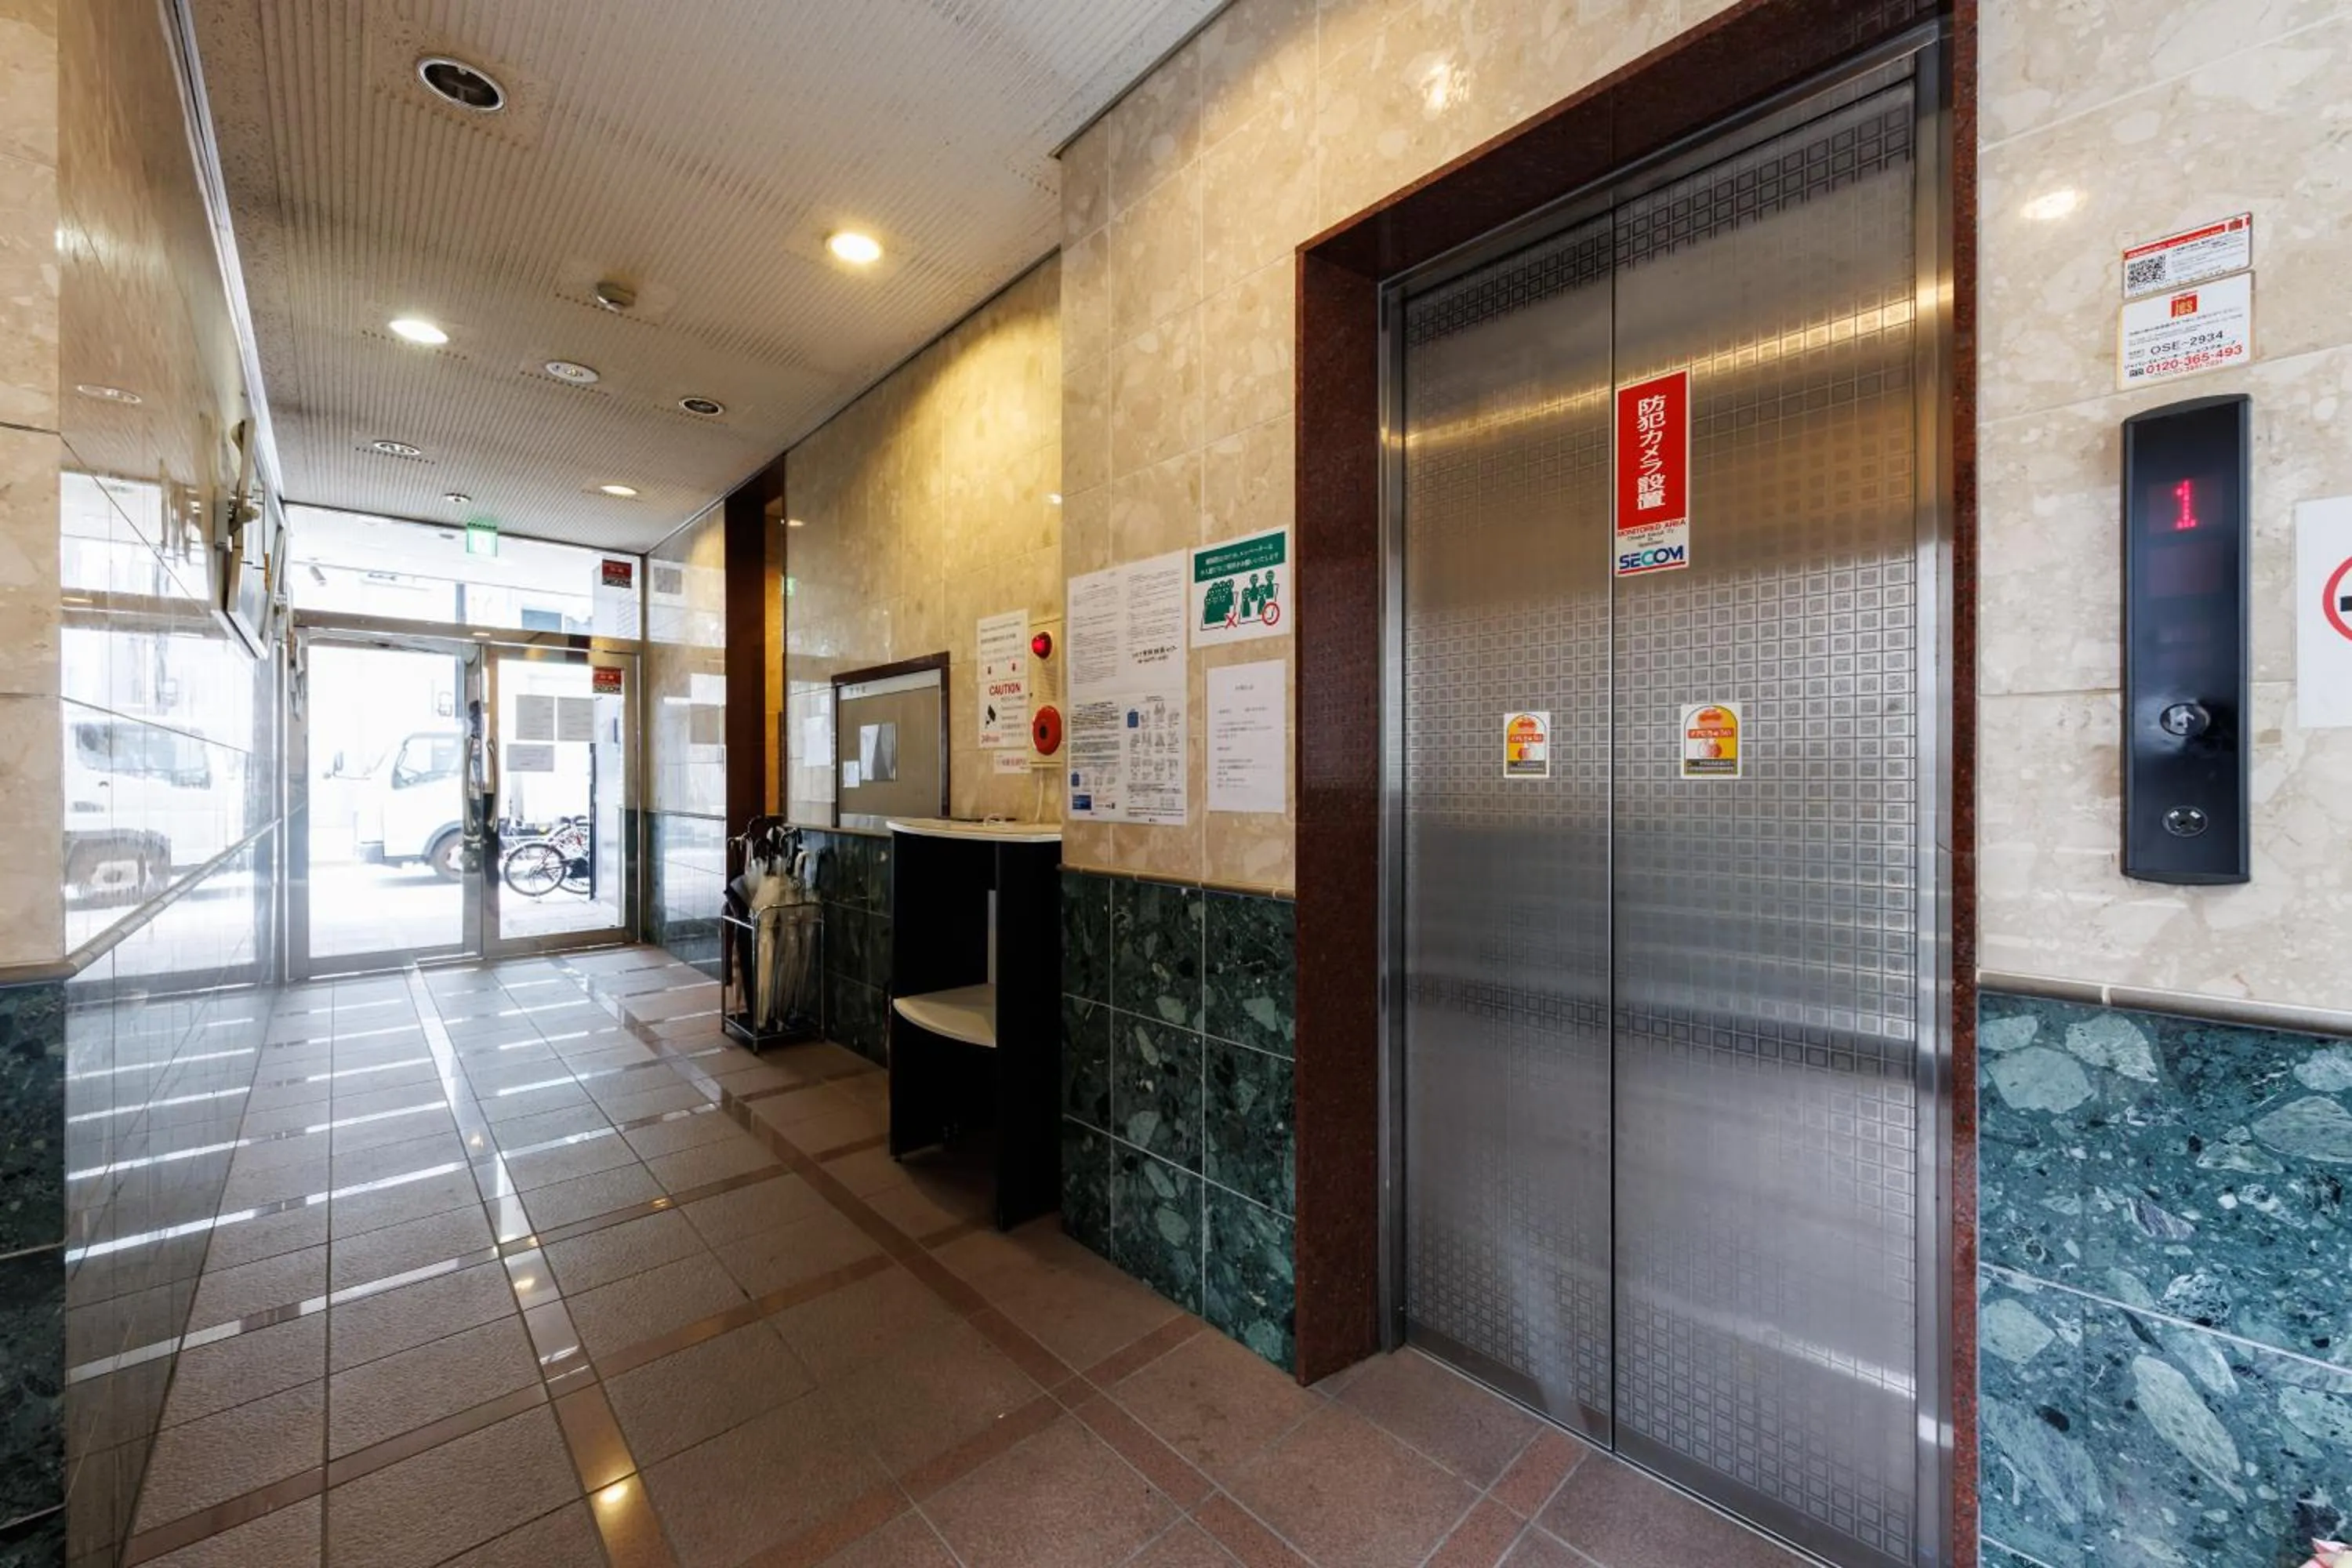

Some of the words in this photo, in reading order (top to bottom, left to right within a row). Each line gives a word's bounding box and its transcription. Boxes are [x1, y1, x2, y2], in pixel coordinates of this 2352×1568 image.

[2146, 344, 2243, 374] 0120-365-493
[1637, 394, 1666, 510] 防犯カメラ設置
[2176, 479, 2197, 529] 1
[1619, 545, 1683, 569] SECOM
[989, 683, 1022, 696] CAUTION
